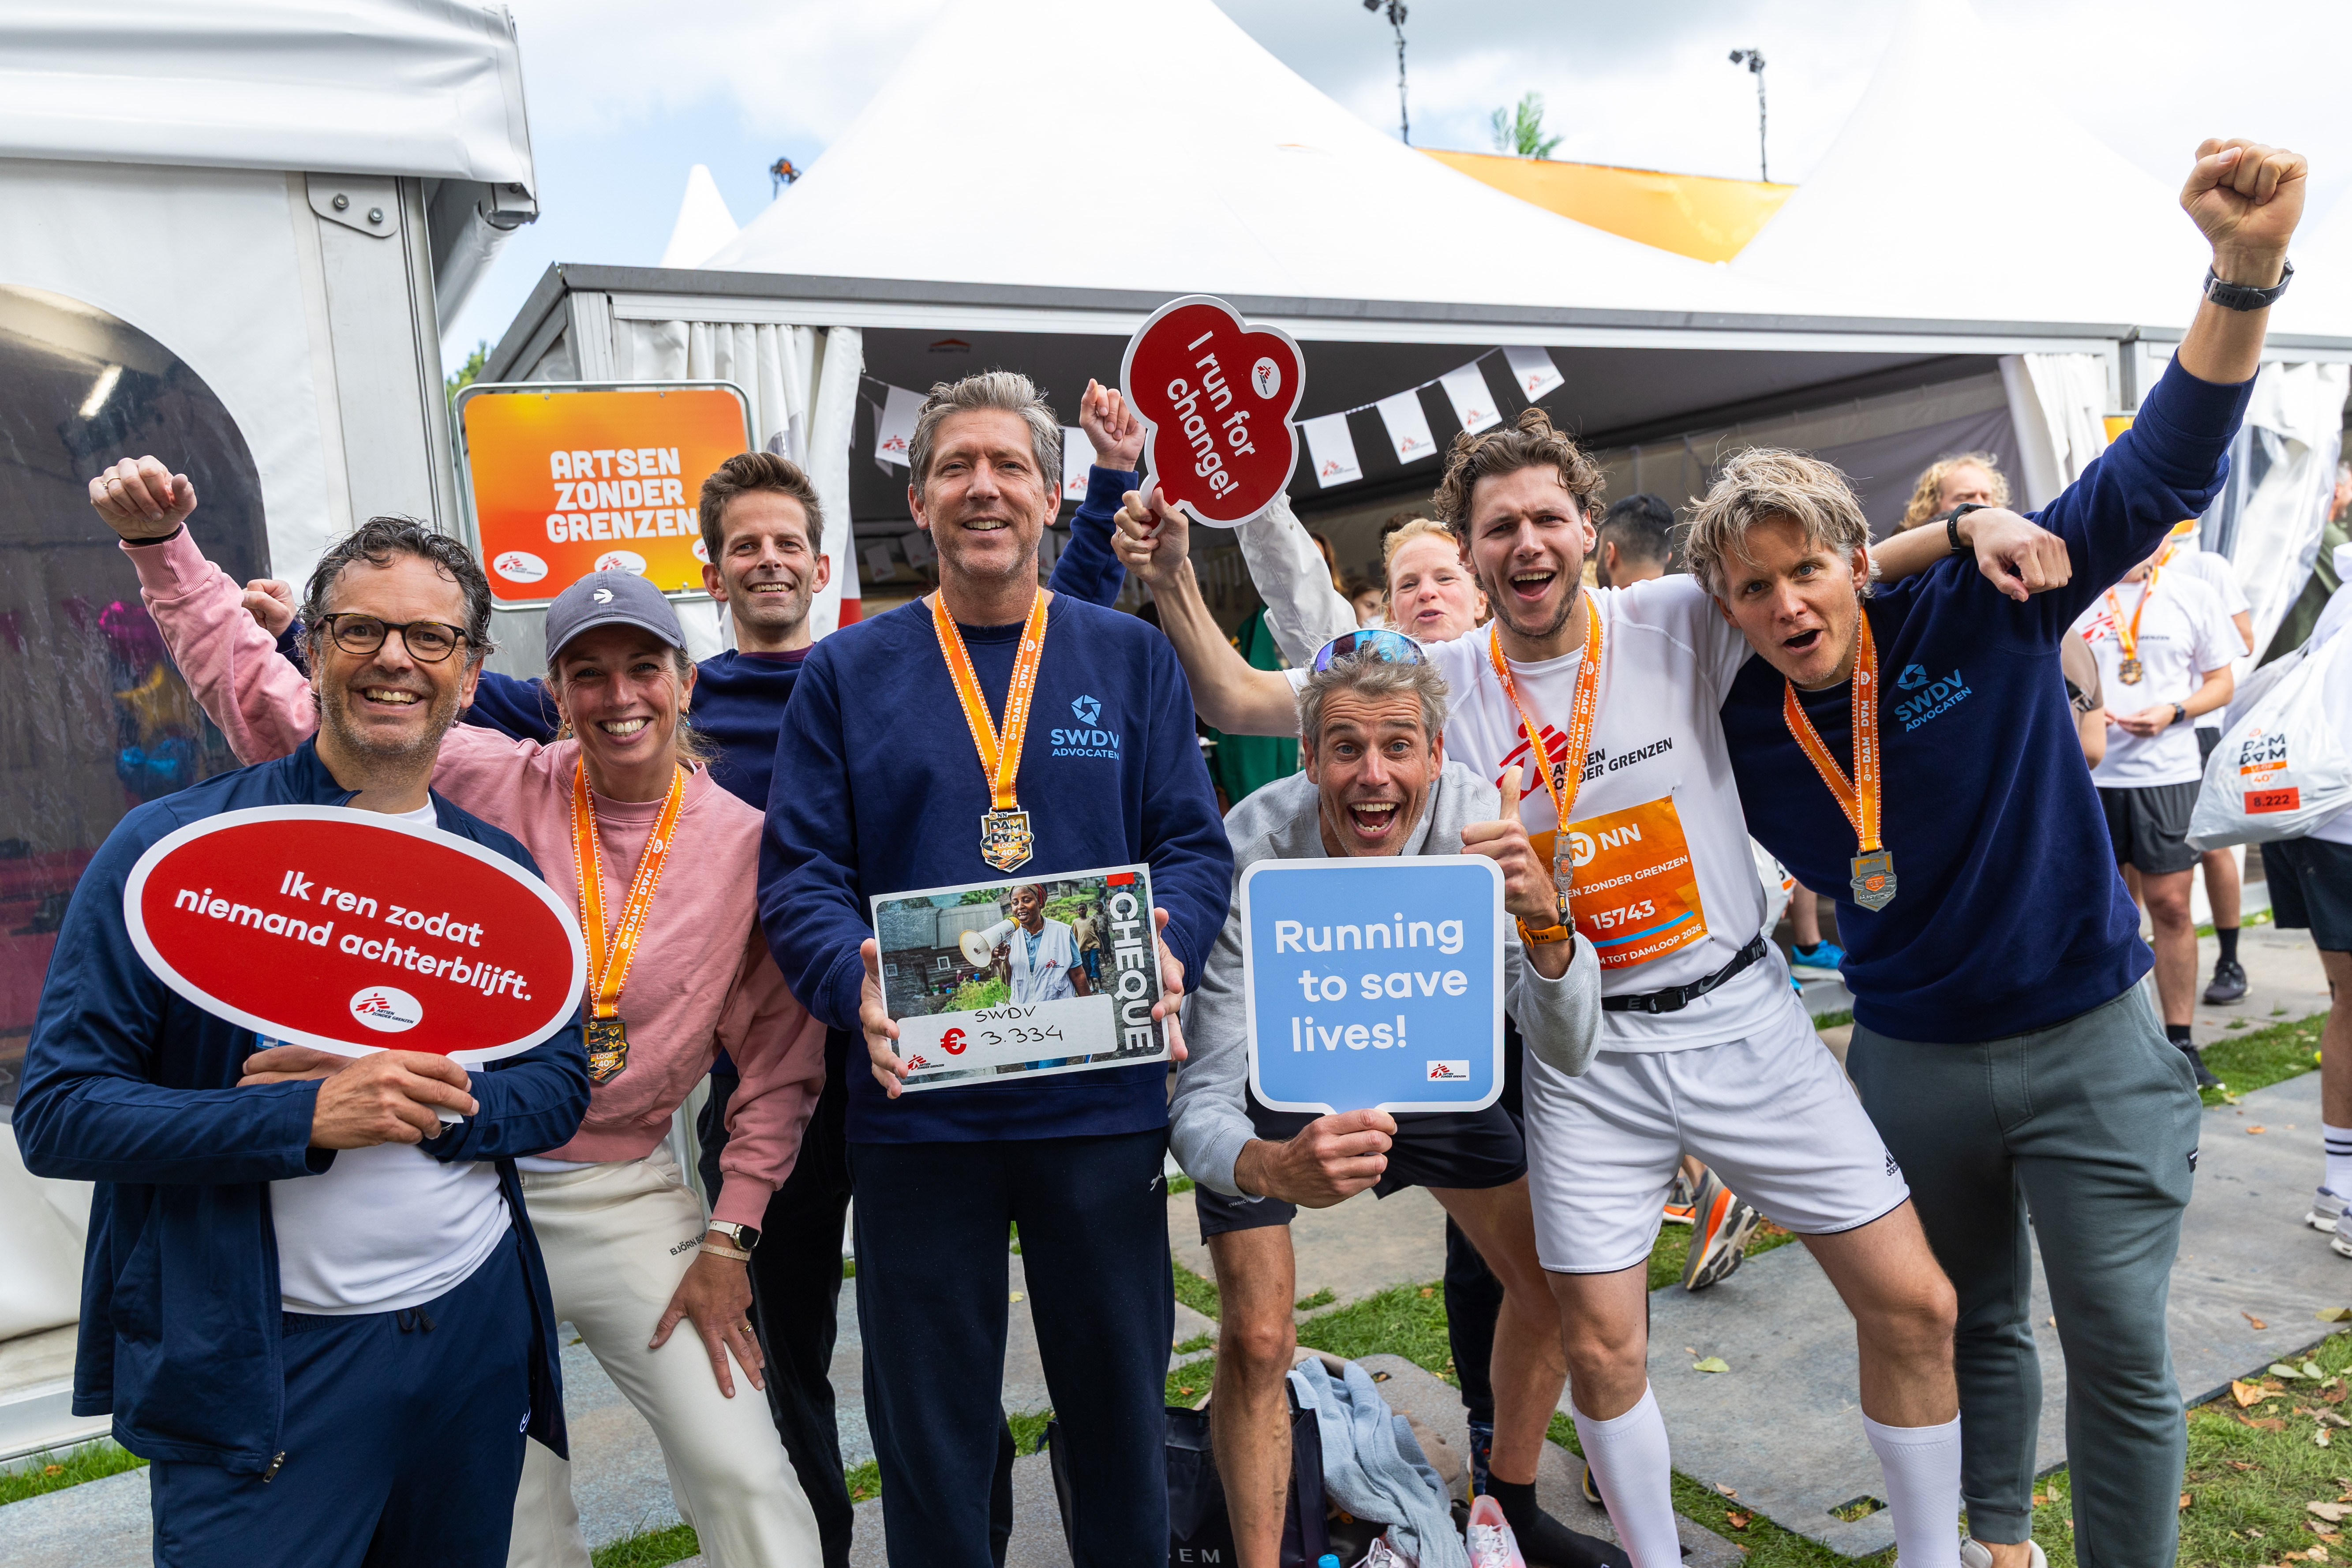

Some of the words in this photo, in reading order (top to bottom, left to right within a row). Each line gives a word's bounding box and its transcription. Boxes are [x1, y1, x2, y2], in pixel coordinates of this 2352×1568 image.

[1187, 330, 1213, 351] I
[1195, 353, 1232, 412] run
[1167, 378, 1239, 500] change!
[1222, 410, 1255, 457] for
[550, 447, 681, 479] ARTSEN
[554, 478, 685, 511] ZONDER
[546, 508, 700, 543] GRENZEN
[1011, 697, 1024, 722] DAM
[1895, 669, 1962, 721] SWDV
[1906, 687, 1972, 732] ADVOCATEN
[1012, 724, 1017, 732] NN
[1050, 729, 1120, 749] SWDV
[1575, 723, 1586, 749] DAM
[1052, 748, 1120, 760] ADVOCATEN
[1553, 748, 1606, 777] AEN
[1575, 750, 1579, 759] NN
[1608, 737, 1673, 771] GRENZEN
[1861, 737, 1871, 763] DAM
[1865, 765, 1869, 773] NN
[2254, 794, 2289, 807] 8.222
[990, 819, 1022, 832] DAM
[1598, 823, 1642, 850] NN
[1583, 874, 1633, 895] ZONDER
[1634, 854, 1689, 880] GRENZEN
[280, 870, 311, 901] Ik
[321, 886, 378, 919] ren
[385, 904, 484, 948] zodat
[626, 904, 641, 932] DAM
[1590, 899, 1655, 930] 15743
[174, 887, 334, 947] niemand
[339, 931, 532, 1002] achterblijft.
[624, 933, 631, 942] NN
[1275, 912, 1463, 954] Running
[1607, 953, 1627, 964] TOT
[1629, 935, 1680, 960] DAMLOOP
[1681, 924, 1702, 940] 2026
[1109, 892, 1155, 1050] CHEQUE
[1298, 970, 1347, 1002] to
[1361, 969, 1468, 999] save
[974, 1006, 1036, 1022] SWDV
[590, 1028, 619, 1043] DAM
[940, 1028, 967, 1055] €
[980, 1025, 1062, 1045] 3.334
[1292, 1015, 1406, 1052] lives!
[670, 1239, 697, 1256] BJÖRN
[696, 1232, 707, 1244] BOR
